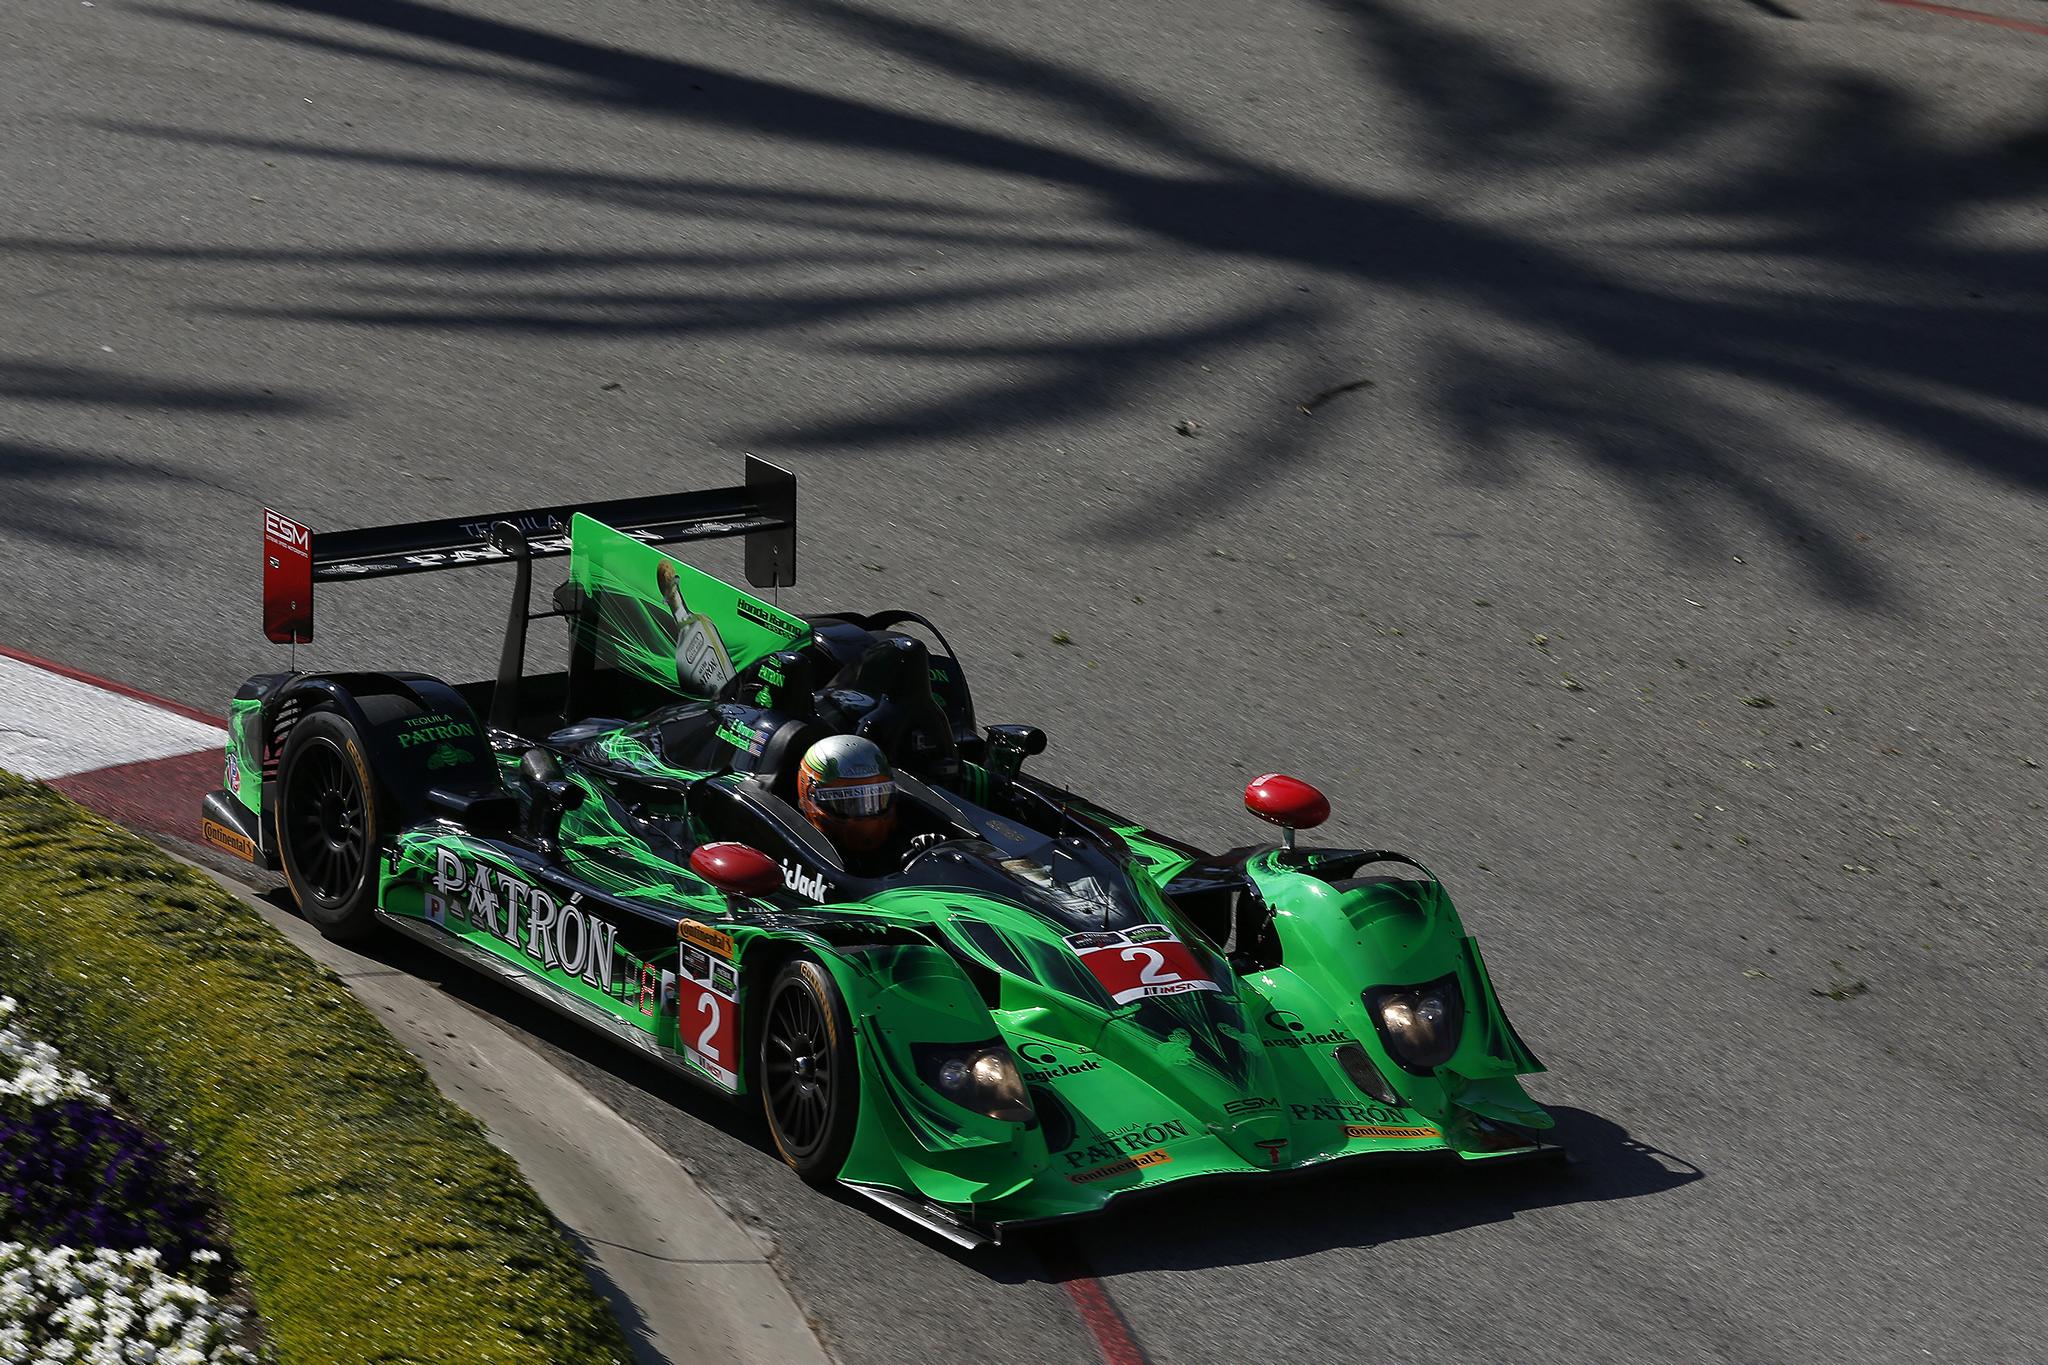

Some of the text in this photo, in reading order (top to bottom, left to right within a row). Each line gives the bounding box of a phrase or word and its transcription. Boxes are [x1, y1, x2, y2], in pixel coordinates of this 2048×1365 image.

[266, 511, 309, 551] ESM
[737, 598, 769, 621] Honda
[398, 721, 475, 748] PATRÓN
[404, 713, 453, 728] TEQUILA
[203, 821, 246, 851] Continental
[782, 858, 828, 904] icJack
[432, 846, 618, 993] PATRÓN
[1120, 946, 1182, 985] 2
[1160, 982, 1197, 995] IMSA
[697, 991, 721, 1061] 2
[1023, 1060, 1101, 1084] agicJack
[1224, 1098, 1281, 1115] ESM
[1290, 1103, 1410, 1124] PATRÓN
[1064, 1119, 1190, 1169] PATRÓN
[1344, 1126, 1422, 1138] Continental
[1071, 1155, 1153, 1184] Continental
